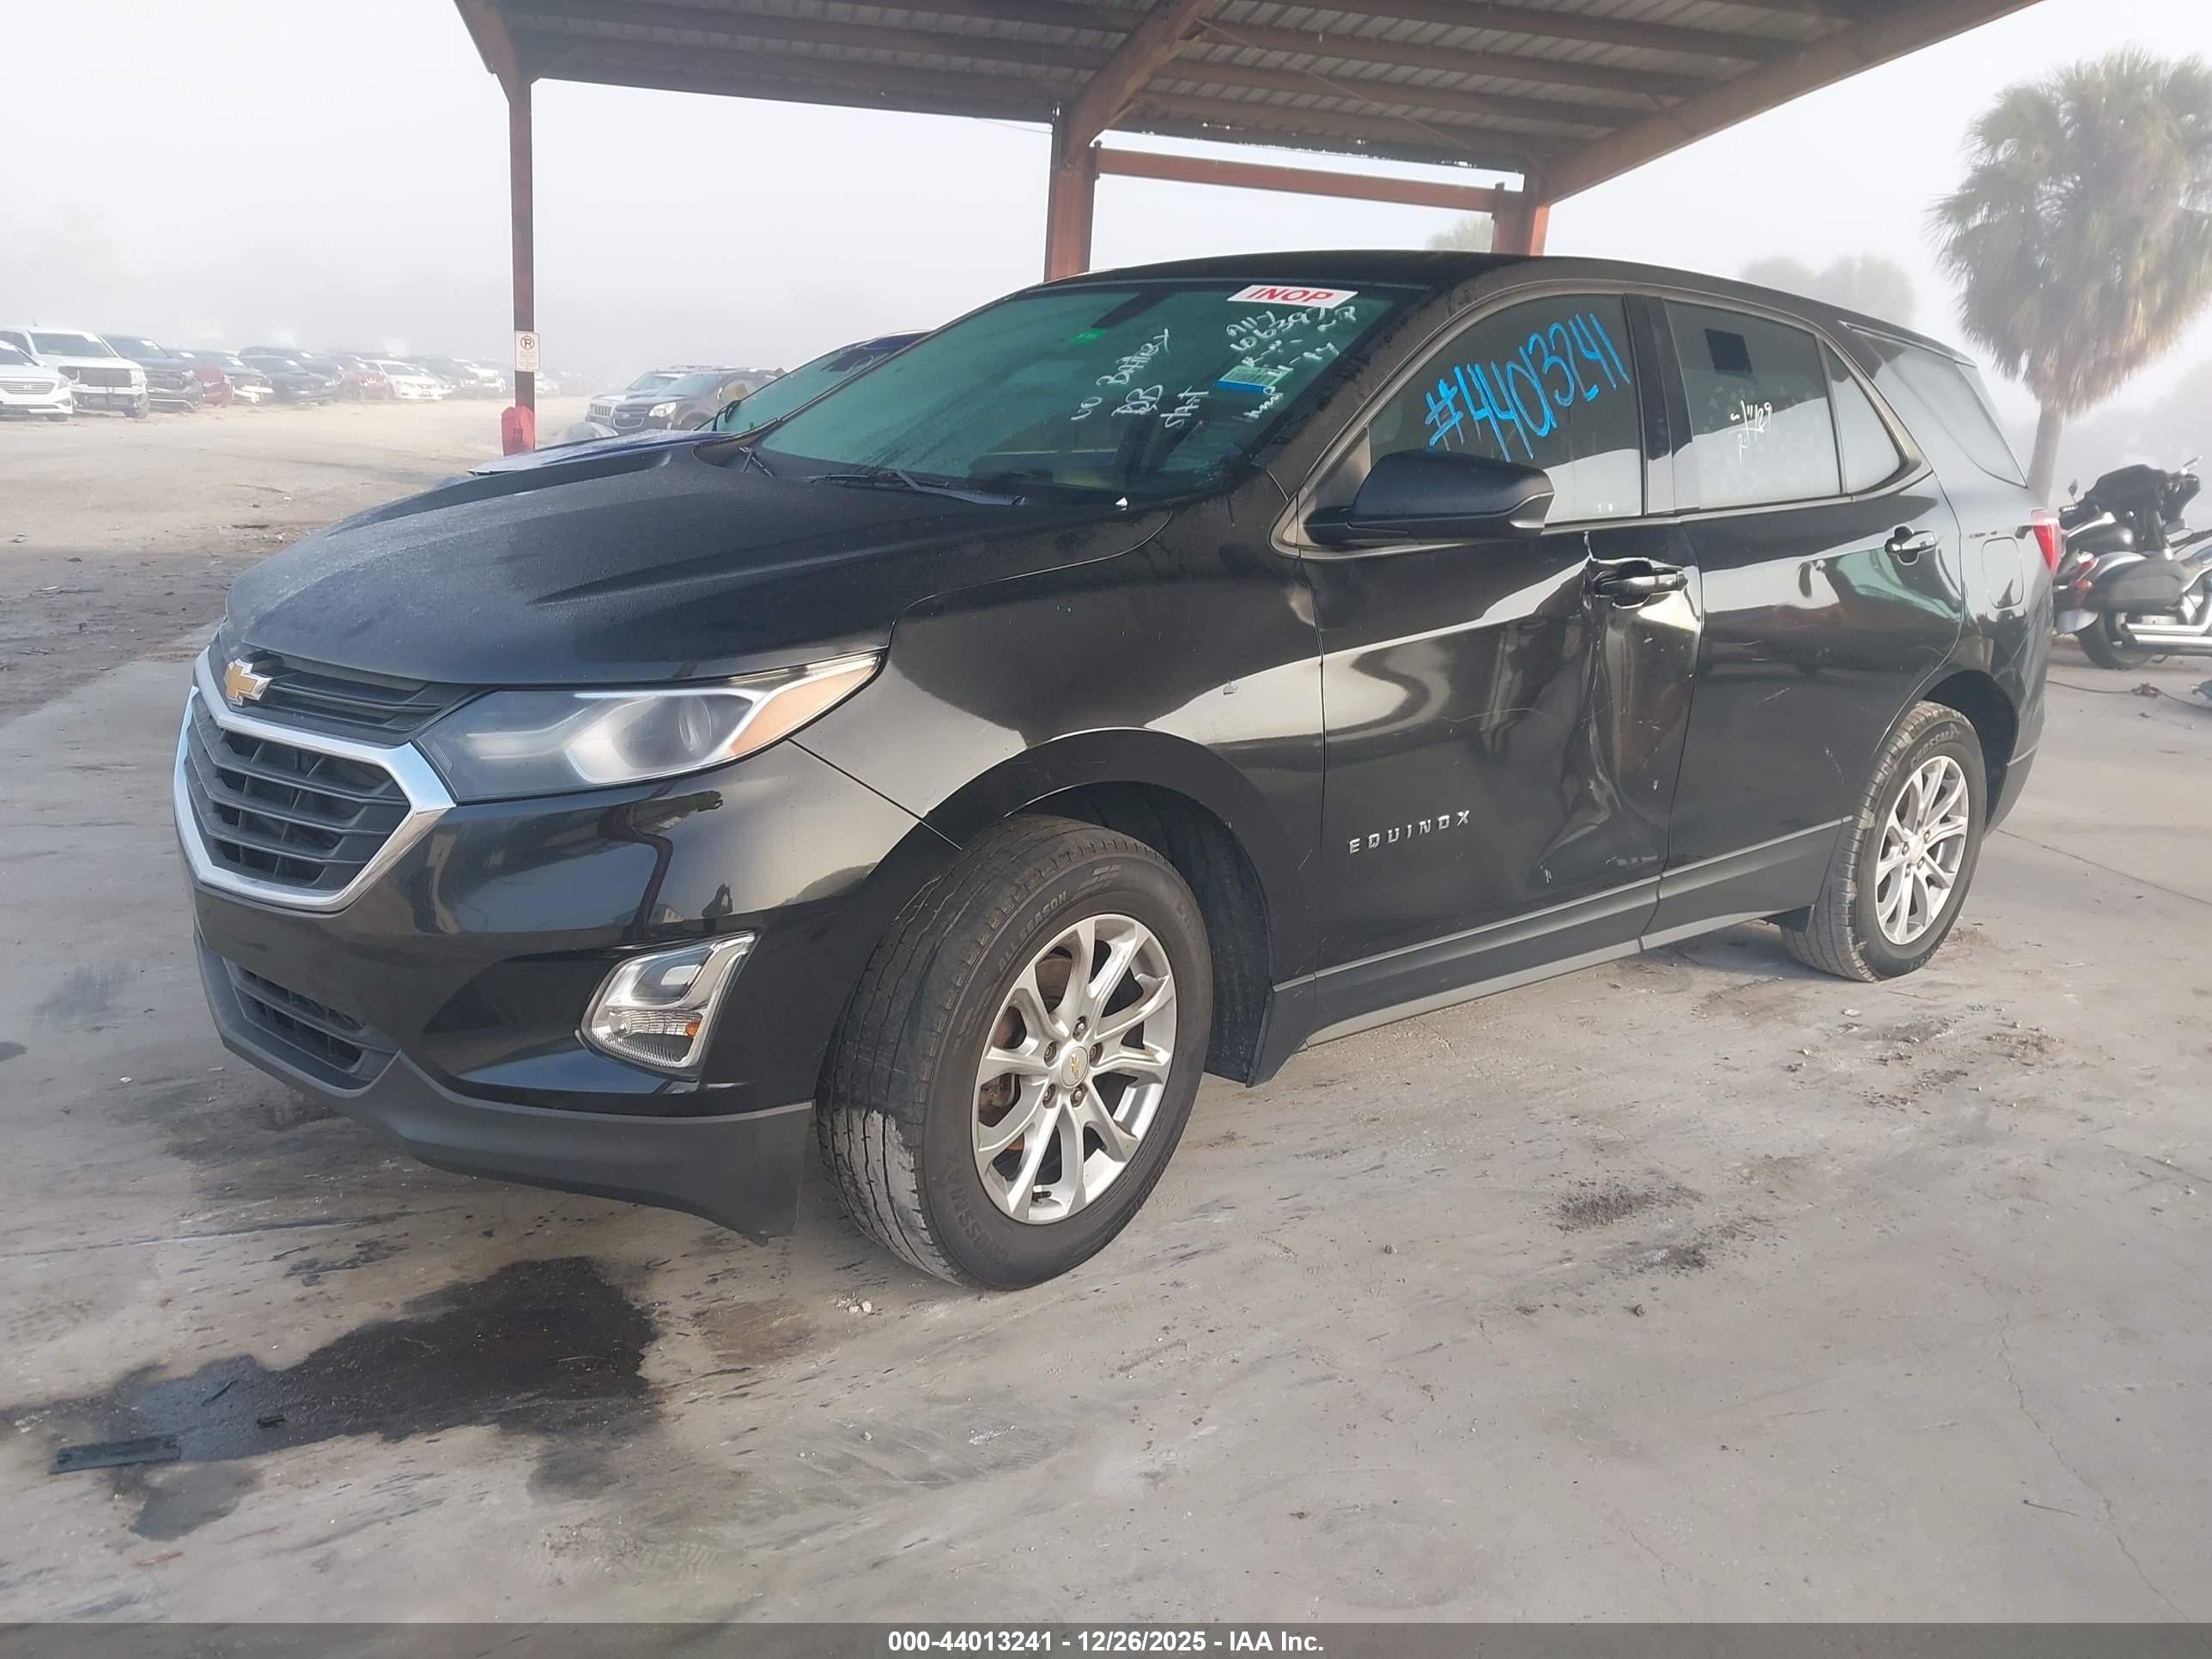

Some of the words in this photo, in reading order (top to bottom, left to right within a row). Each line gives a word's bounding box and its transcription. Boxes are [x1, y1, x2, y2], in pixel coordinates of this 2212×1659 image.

[1247, 288, 1334, 303] INOP
[1349, 810, 1470, 854] EQUINOX
[999, 944, 1020, 971] ALL
[1018, 890, 1067, 941] SEASON
